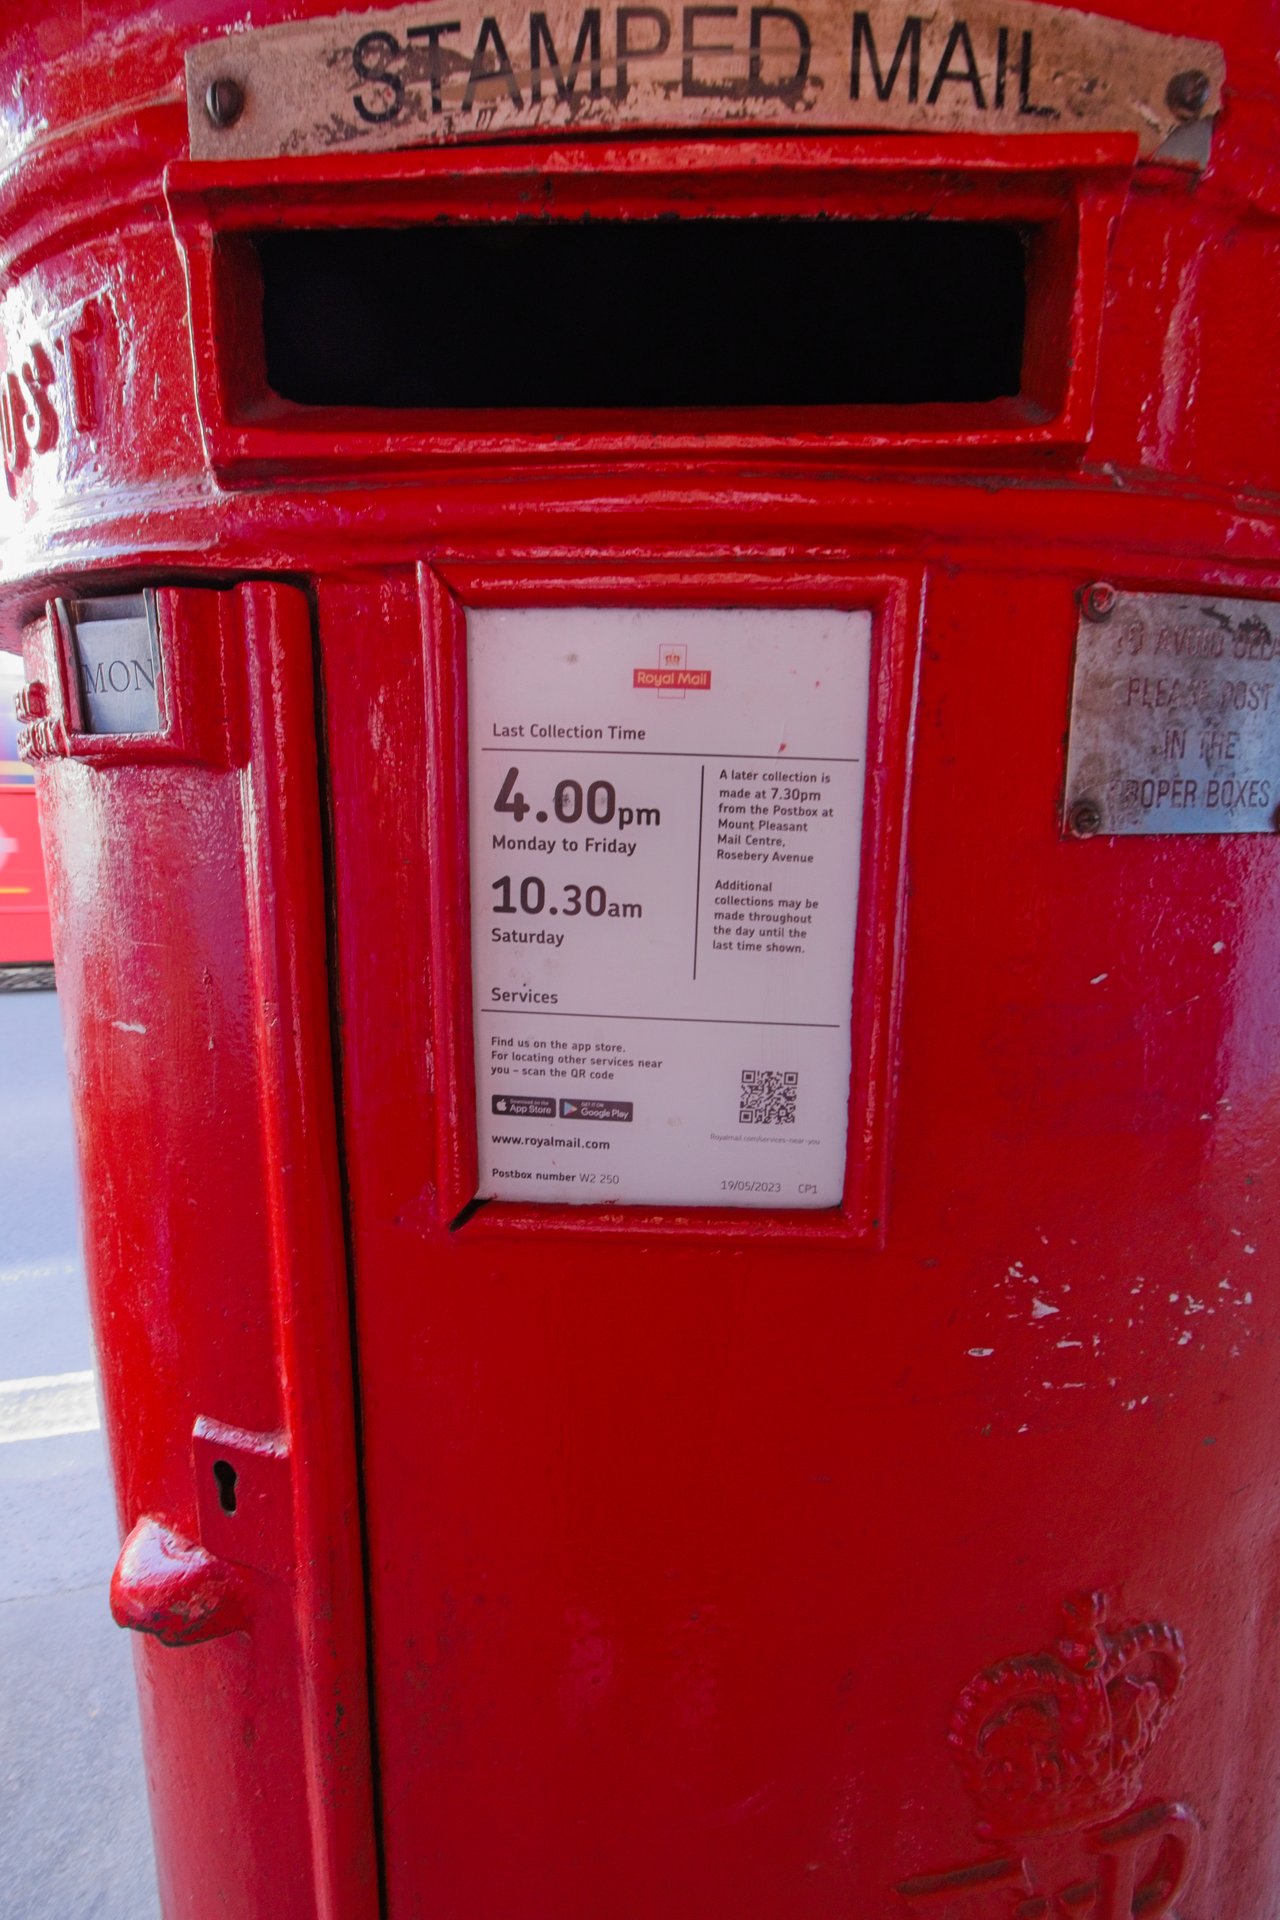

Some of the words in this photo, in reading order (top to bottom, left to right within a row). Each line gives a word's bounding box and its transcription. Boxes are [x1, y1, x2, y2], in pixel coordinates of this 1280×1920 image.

[352, 6, 812, 123] STAMPED
[850, 11, 1062, 119] MAIL
[80, 658, 156, 695] MON
[637, 670, 675, 687] Royal
[678, 672, 708, 686] Mail
[1126, 676, 1210, 708] PLEASE
[1219, 680, 1275, 713] POST
[493, 723, 525, 738] Last
[530, 724, 603, 739] Collection
[608, 725, 646, 740] Time
[1163, 729, 1186, 759] IN
[1200, 730, 1240, 760] THE
[719, 769, 728, 780] A
[731, 769, 758, 780] later
[762, 771, 817, 783] collection
[821, 772, 831, 783] is
[494, 766, 661, 831] 4.00pm
[719, 788, 750, 799] made
[755, 789, 766, 799] at
[771, 787, 821, 802] 7.30pm
[1206, 779, 1271, 808] BOXES
[718, 802, 746, 814] from
[750, 804, 769, 815] the
[773, 804, 818, 816] Postbox
[821, 807, 834, 817] at
[718, 818, 755, 830] Mount
[758, 819, 808, 832] Pleasant
[492, 835, 556, 854] Monday
[562, 838, 578, 851] to
[585, 838, 637, 857] Friday
[717, 834, 741, 845] Mail
[745, 834, 786, 847] Centre,
[717, 849, 769, 863] Rosebery
[772, 852, 814, 863] Avenue
[714, 880, 772, 892] Additional
[492, 875, 643, 918] 10.30am
[714, 895, 774, 907] collections
[778, 898, 802, 910] may
[805, 899, 819, 909] be
[714, 911, 745, 920] made
[748, 912, 812, 925] throughout
[491, 928, 565, 948] Saturday
[713, 925, 732, 935] the
[735, 926, 756, 938] day
[758, 928, 784, 938] until
[788, 928, 807, 939] the
[712, 940, 733, 950] last
[736, 941, 762, 952] time
[765, 942, 805, 954] shown.
[491, 987, 559, 1004] Services
[491, 1037, 514, 1047] Find
[517, 1038, 530, 1048] us
[533, 1040, 547, 1048] on
[550, 1039, 568, 1050] the
[571, 1041, 592, 1052] app
[594, 1042, 626, 1053] store.
[491, 1051, 509, 1060] For
[511, 1051, 554, 1065] locating
[557, 1053, 587, 1065] other
[590, 1056, 634, 1067] services
[637, 1059, 663, 1068] near
[490, 1066, 510, 1076] you
[521, 1067, 546, 1077] scan
[549, 1067, 567, 1078] the
[570, 1069, 586, 1079] QR
[589, 1069, 614, 1080] code
[509, 1103, 528, 1114] App
[529, 1104, 552, 1114] Store
[580, 1107, 610, 1119] Google
[611, 1109, 629, 1120] Play
[492, 1135, 610, 1149] www.royalmail.com
[492, 1168, 532, 1179] Postbox
[535, 1172, 576, 1182] number
[579, 1174, 596, 1183] W2
[600, 1175, 619, 1184] 250
[720, 1180, 781, 1193] 19/05/2023
[797, 1183, 818, 1194] CP1
